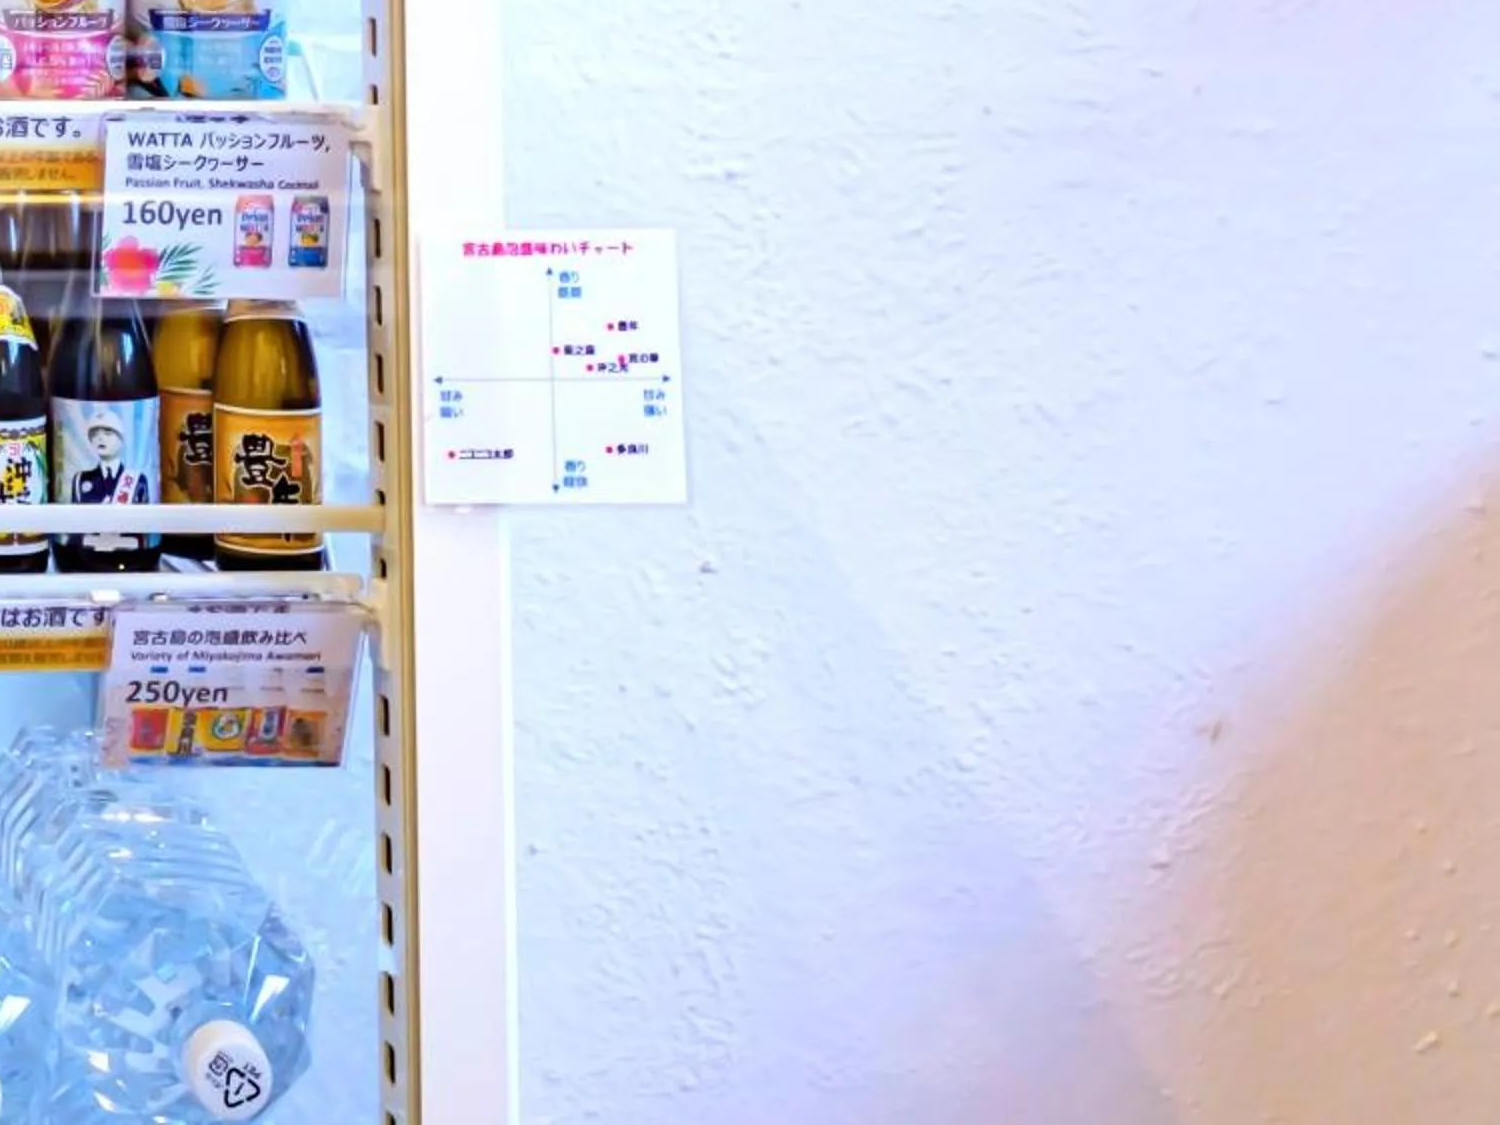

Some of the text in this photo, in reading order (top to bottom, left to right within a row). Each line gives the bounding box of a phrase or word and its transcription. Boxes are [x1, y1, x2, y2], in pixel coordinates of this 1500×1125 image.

[127, 131, 194, 148] WATTA
[125, 177, 171, 189] Passion
[121, 200, 223, 230] 160yen
[132, 629, 308, 646] 宮古島の泡盛飲み比べ
[131, 650, 173, 662] Variety
[176, 650, 190, 661] of
[192, 650, 263, 663] Miyakojima
[124, 680, 229, 706] 250yen
